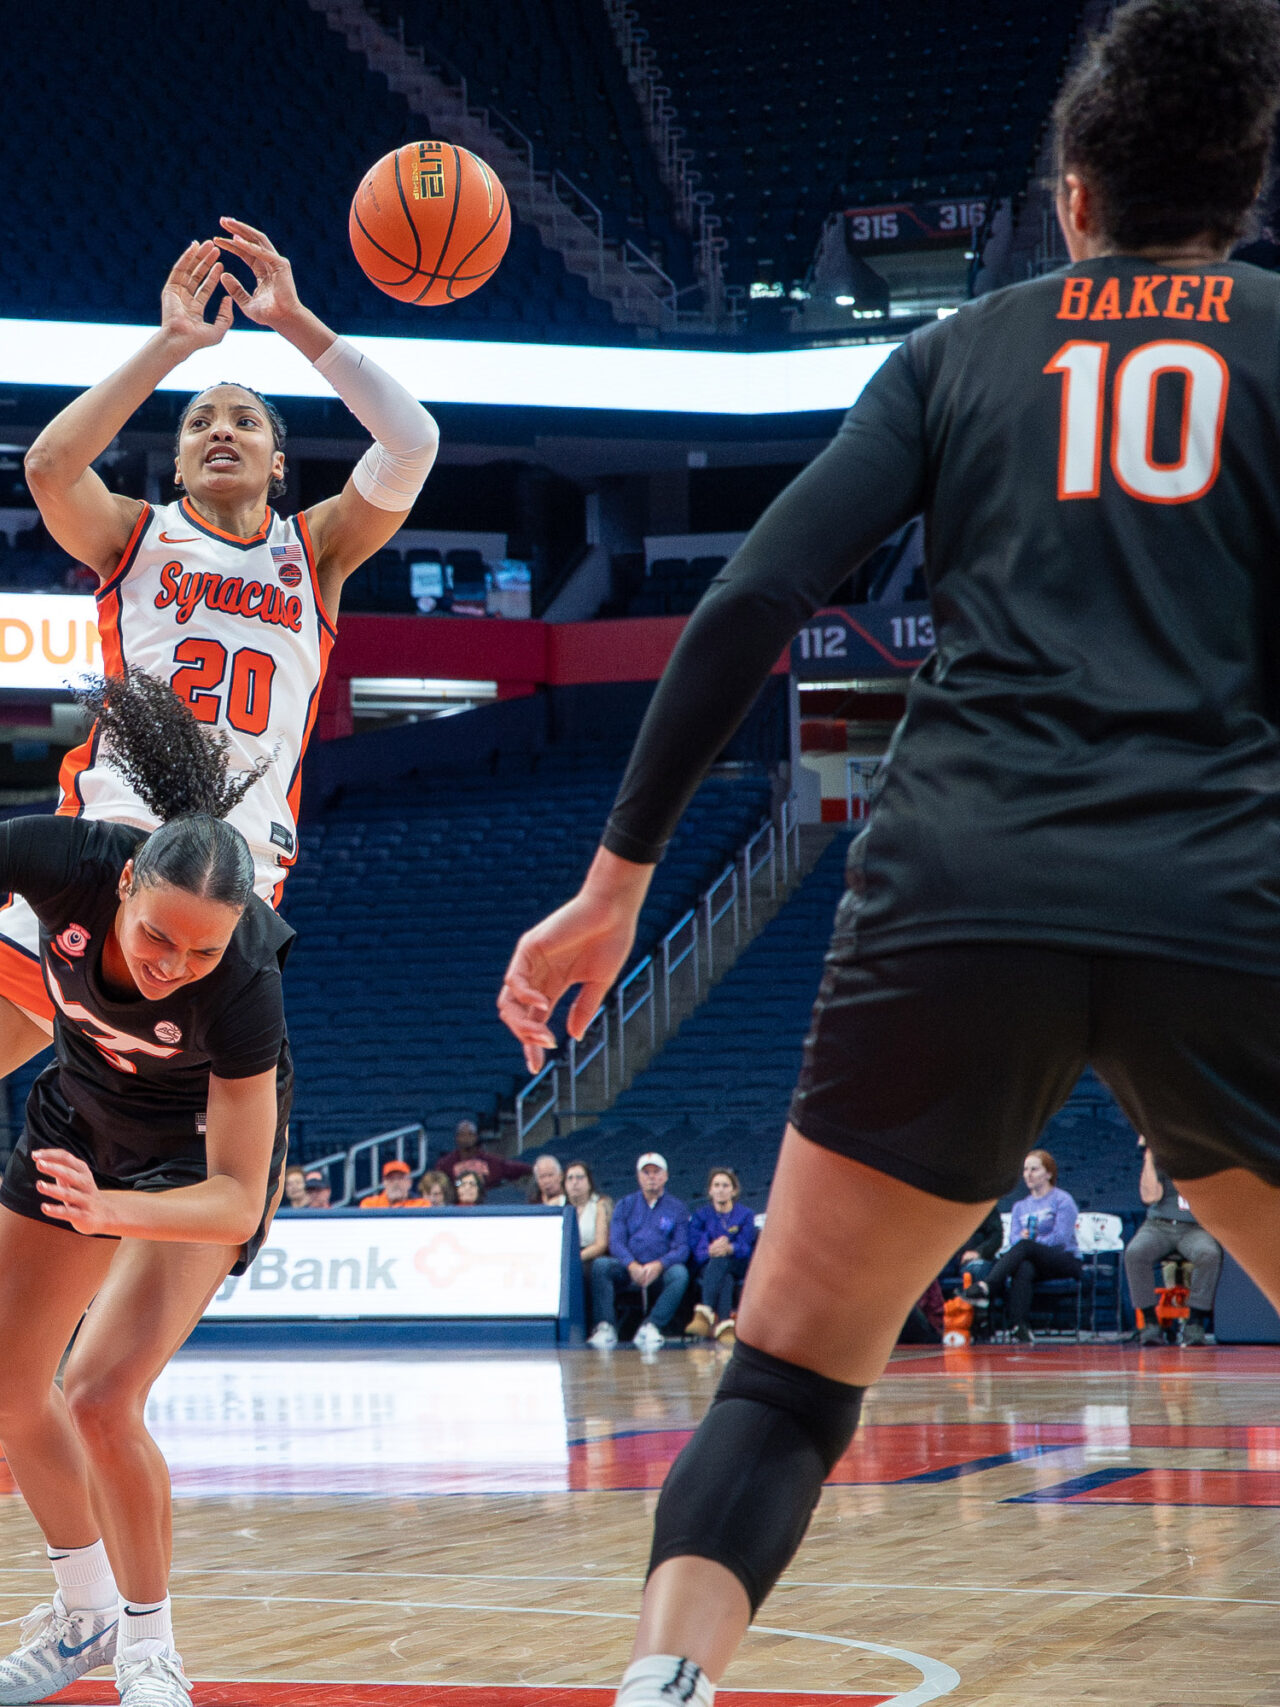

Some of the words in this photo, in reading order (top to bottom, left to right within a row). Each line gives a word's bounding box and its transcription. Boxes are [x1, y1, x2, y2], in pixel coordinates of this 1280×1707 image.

[852, 213, 899, 241] 315
[938, 202, 986, 231] 316
[1056, 275, 1234, 323] BAKER
[1042, 338, 1231, 505] 10
[154, 560, 303, 633] Syracuse
[798, 625, 848, 659] 112
[890, 615, 937, 648] 113
[170, 637, 277, 737] 20
[216, 1246, 397, 1302] yBank
